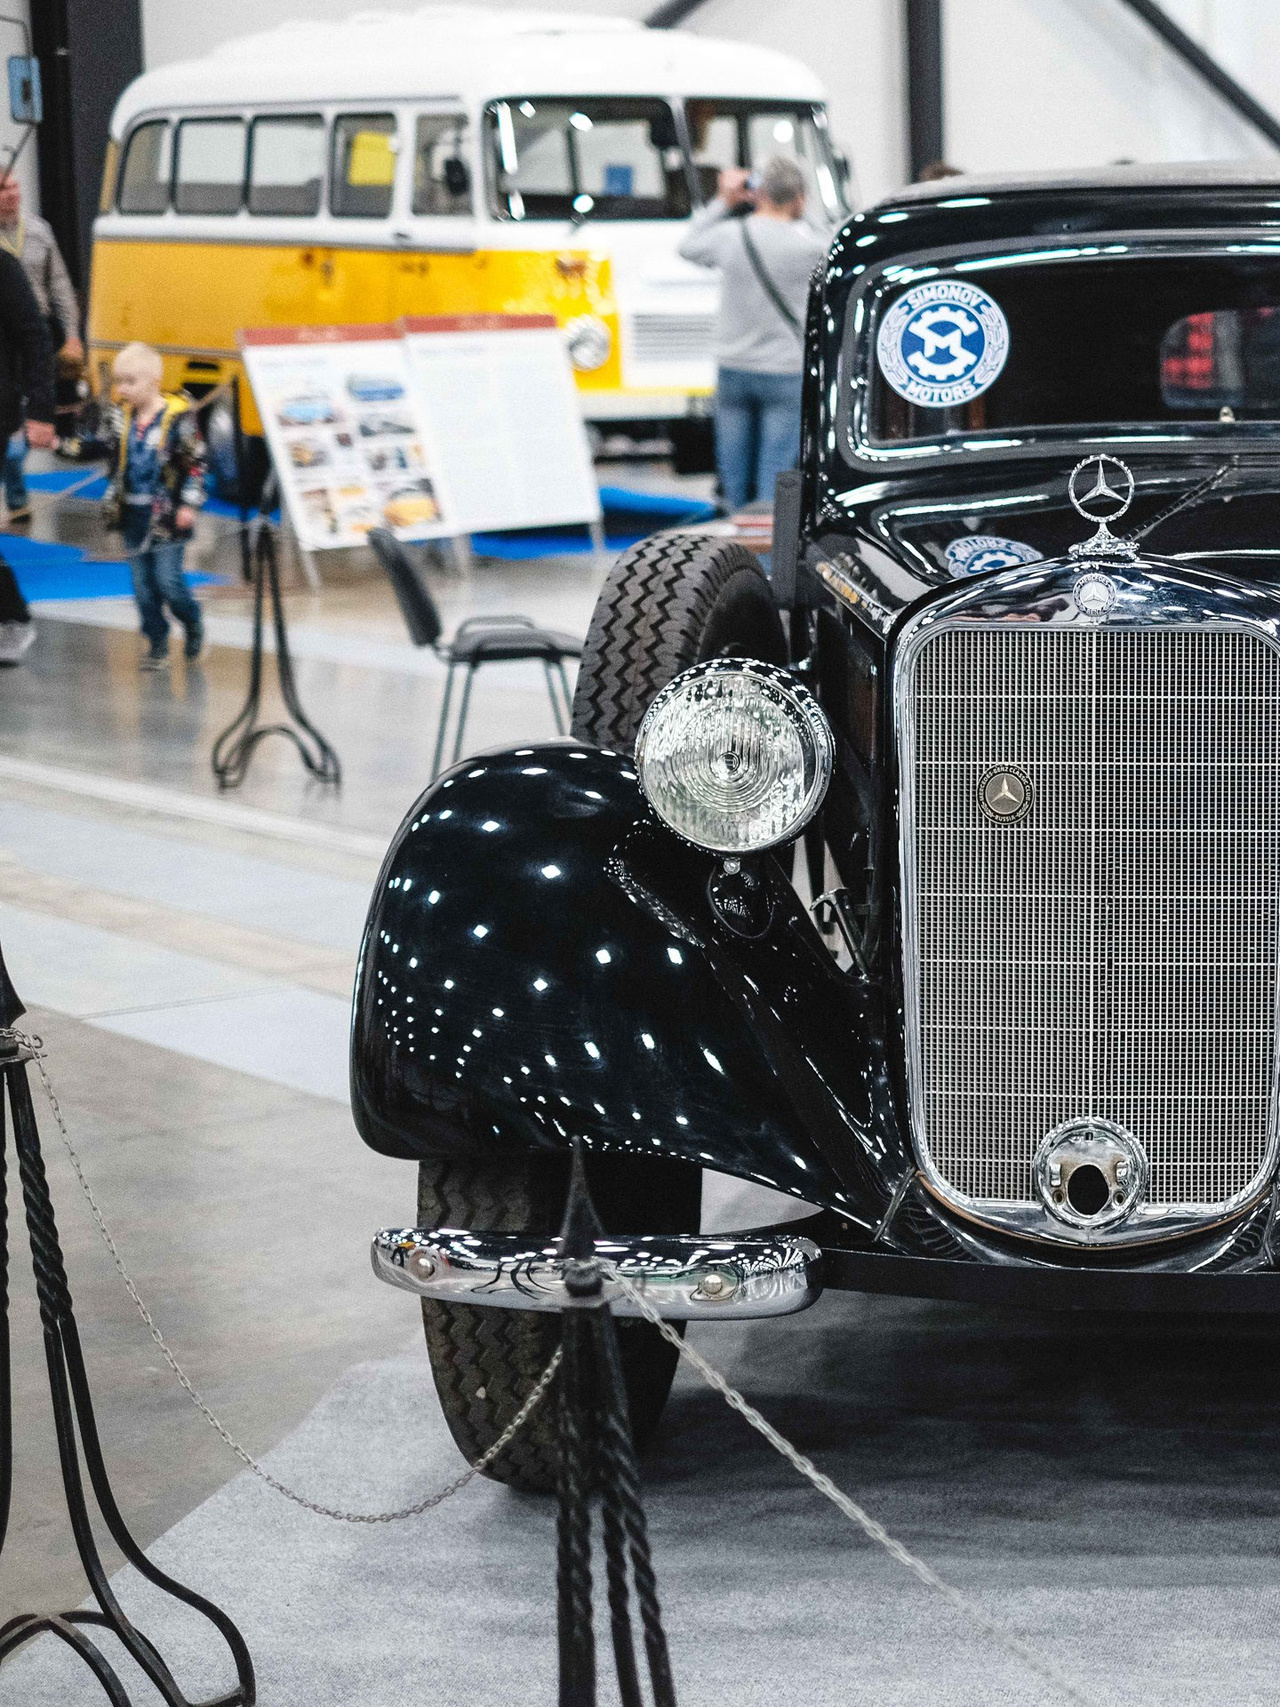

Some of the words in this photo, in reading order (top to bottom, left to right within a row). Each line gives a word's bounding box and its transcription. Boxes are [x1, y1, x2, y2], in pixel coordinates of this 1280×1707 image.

[907, 286, 983, 309] SIMONOV
[905, 380, 976, 402] MOTORS
[1009, 766, 1029, 785] CLASSIC
